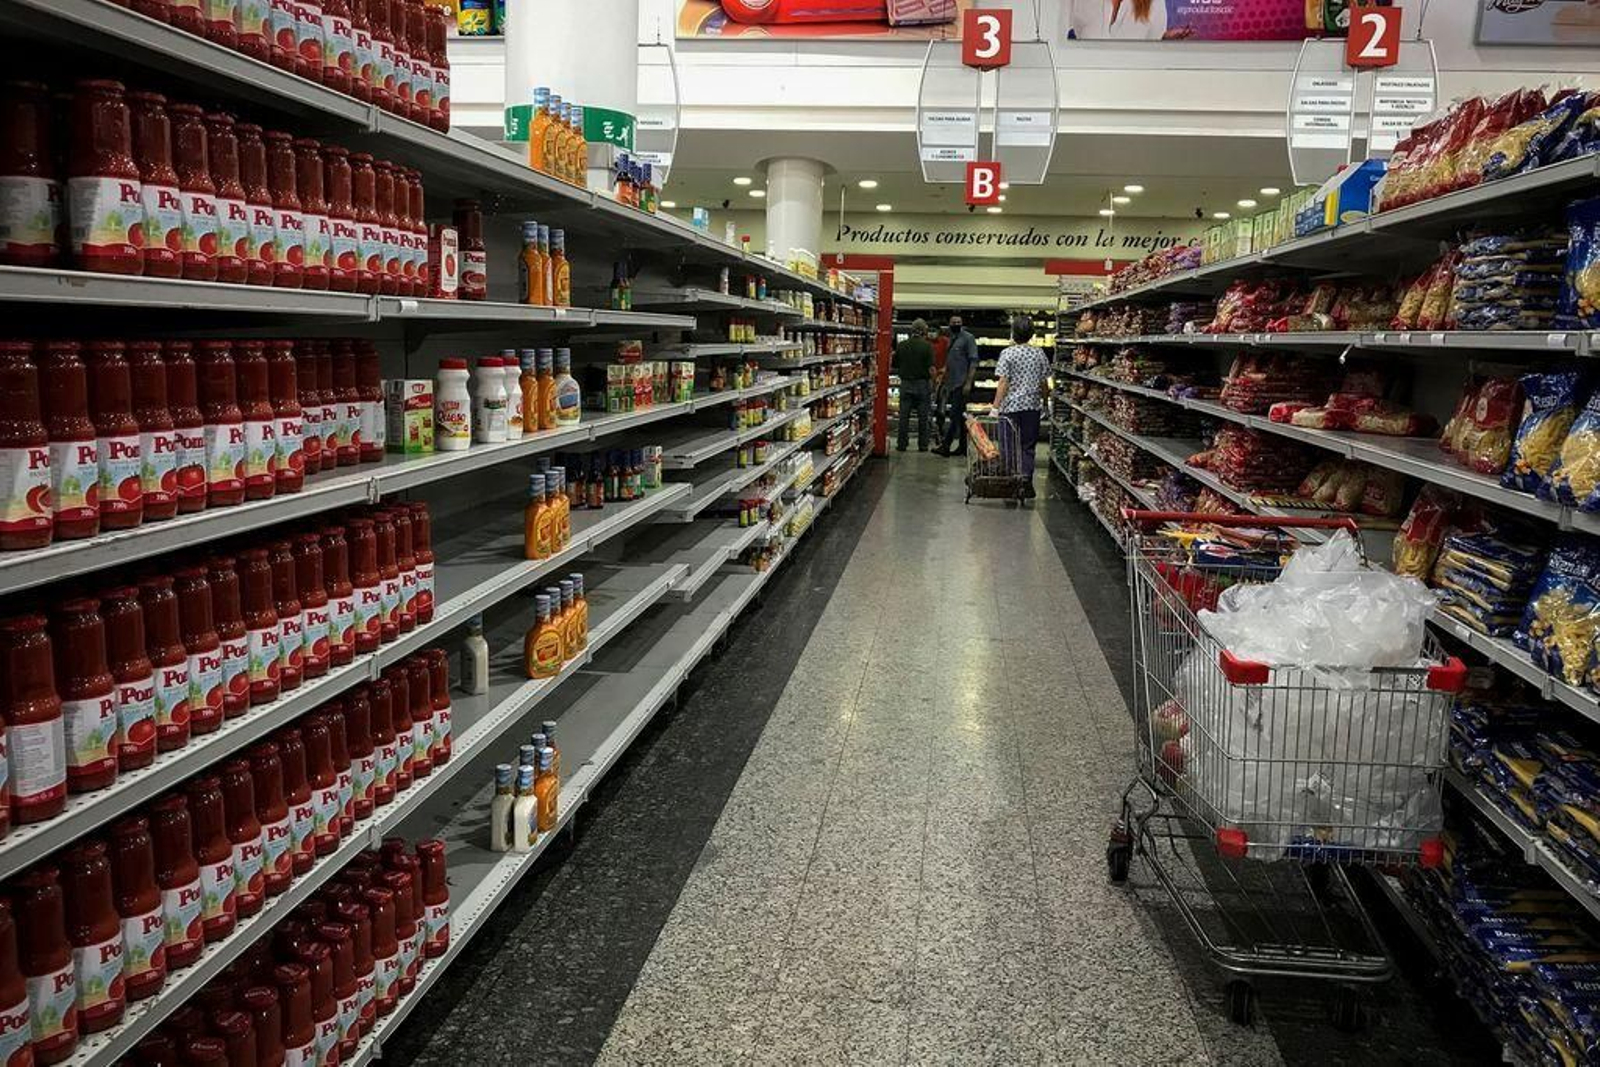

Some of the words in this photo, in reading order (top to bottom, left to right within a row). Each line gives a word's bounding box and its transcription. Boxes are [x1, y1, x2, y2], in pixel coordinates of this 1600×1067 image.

[975, 15, 1001, 59] 3
[1358, 13, 1388, 57] 2
[972, 167, 994, 198] B
[836, 224, 930, 243] Productos
[935, 227, 1050, 246] conservados
[1056, 233, 1088, 247] con
[1095, 229, 1115, 247] la
[1122, 231, 1181, 253] mejor
